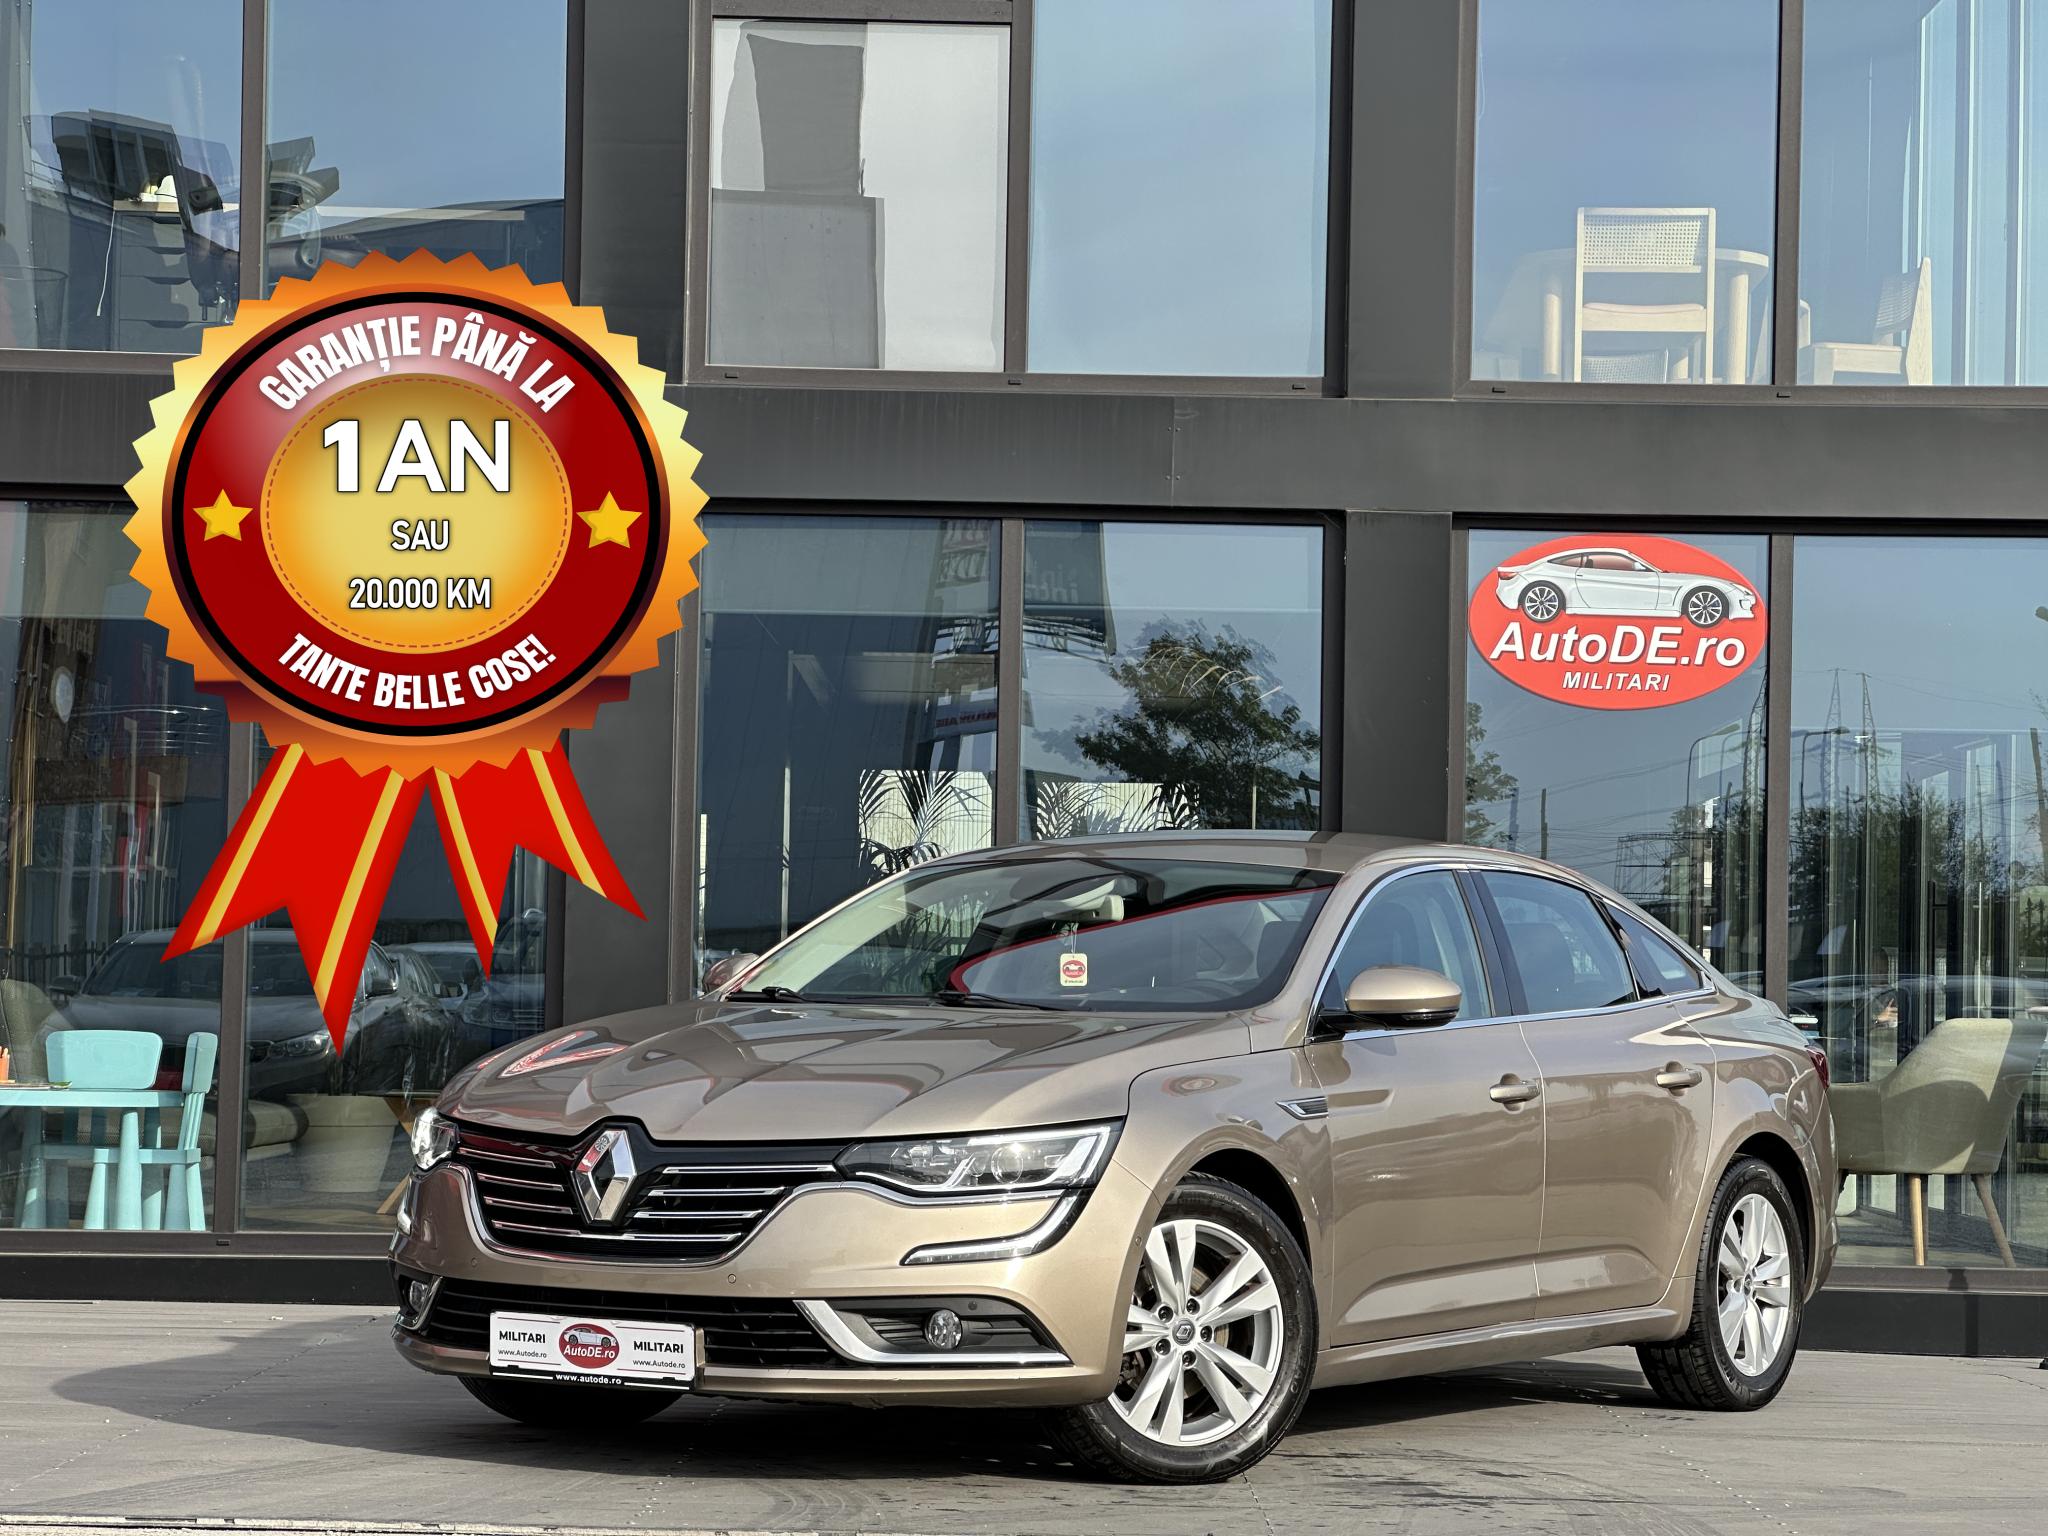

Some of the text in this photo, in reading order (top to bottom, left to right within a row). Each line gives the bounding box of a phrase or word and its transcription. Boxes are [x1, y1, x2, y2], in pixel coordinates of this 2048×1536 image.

[1490, 621, 1746, 667] AutoDE.ro
[1562, 671, 1671, 692] MILITARI
[499, 1330, 546, 1344] MILITARI
[498, 1348, 547, 1359] www.Autode.ro
[563, 1344, 616, 1359] AutoDE.ro
[633, 1340, 684, 1354] MILITARI
[633, 1359, 686, 1369] www.Autode.ro
[555, 1373, 622, 1385] www.autode.ro
